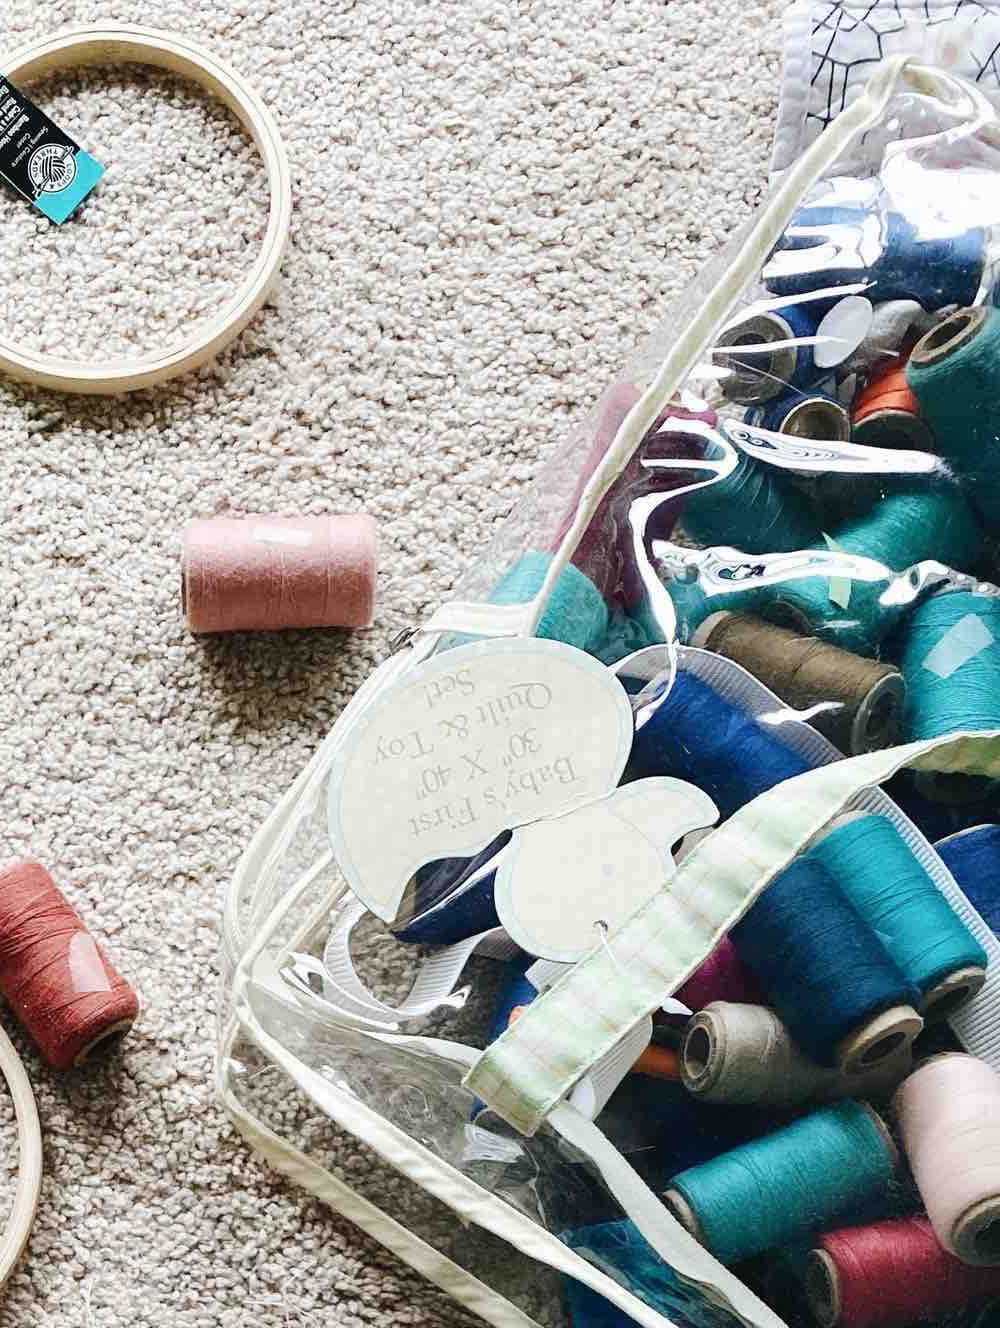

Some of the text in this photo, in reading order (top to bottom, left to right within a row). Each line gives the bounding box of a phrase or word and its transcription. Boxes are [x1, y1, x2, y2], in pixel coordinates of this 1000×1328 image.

[7, 113, 29, 138] Bamboo
[422, 670, 475, 706] Set!
[372, 682, 553, 766] Quilt & Toy
[458, 750, 485, 777] X
[408, 755, 577, 840] Baby's First
